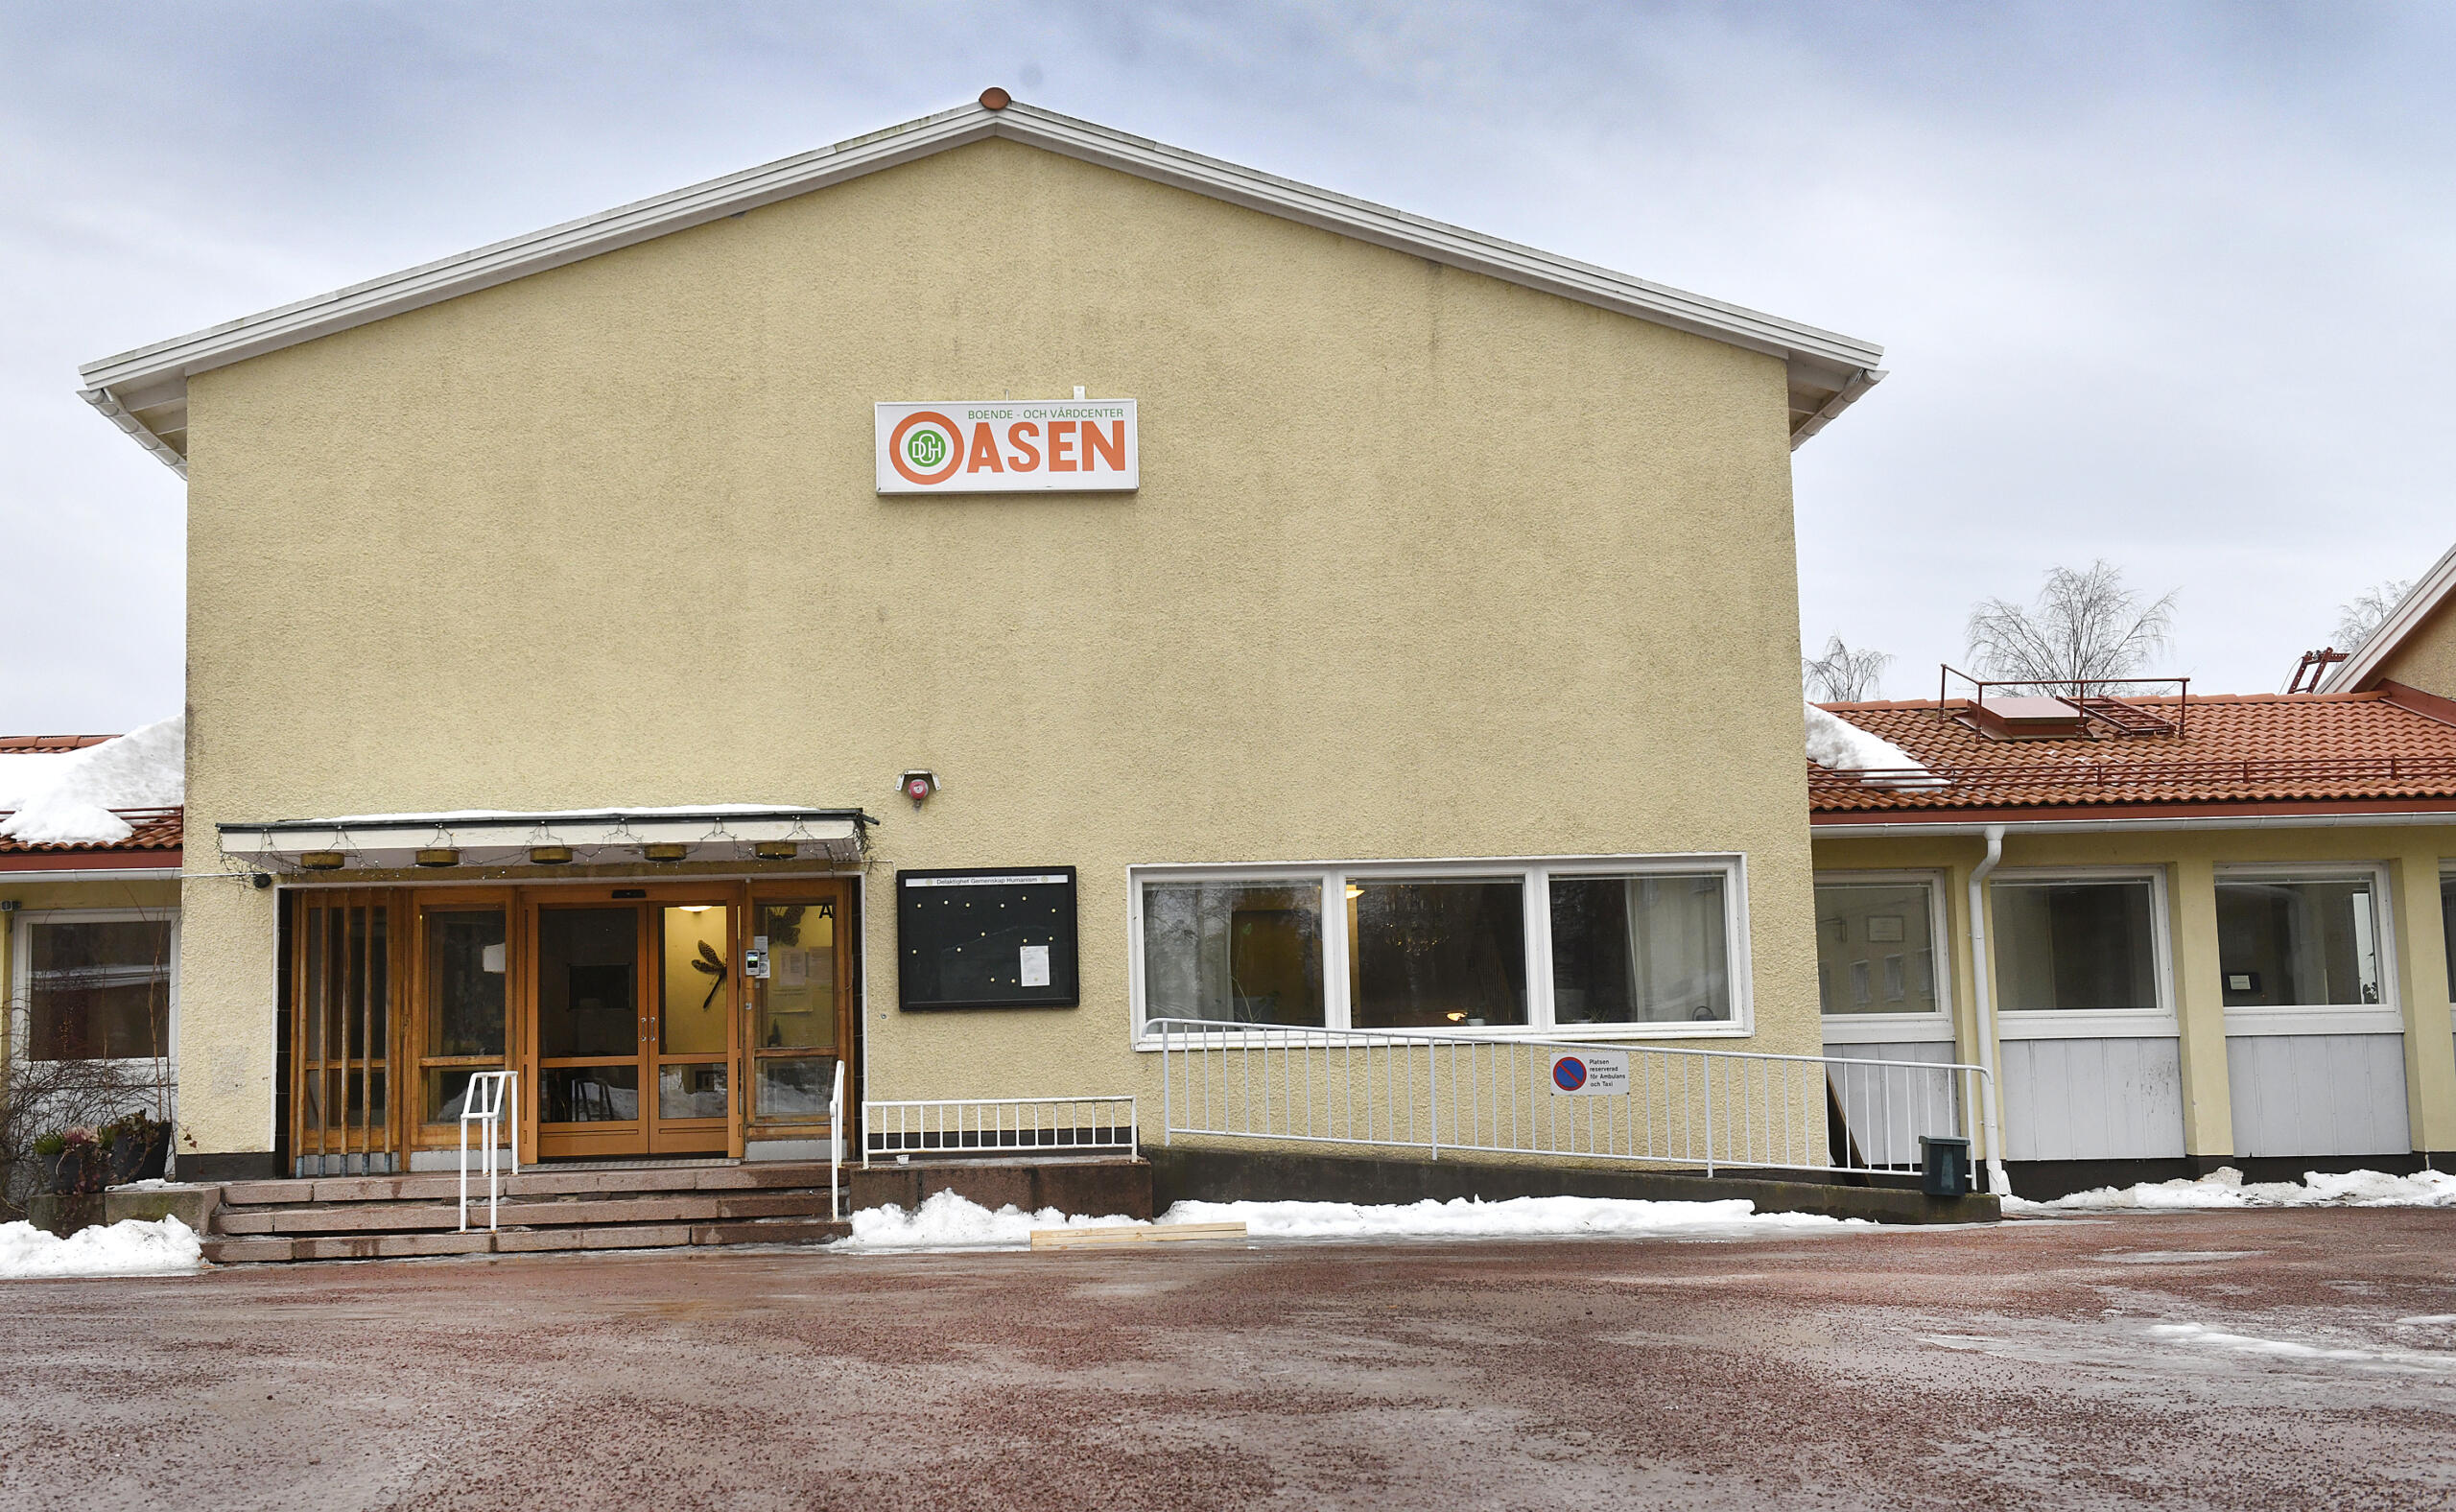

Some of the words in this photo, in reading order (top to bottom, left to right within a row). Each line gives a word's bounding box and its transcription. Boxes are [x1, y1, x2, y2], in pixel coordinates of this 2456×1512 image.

[967, 410, 1013, 420] BOENDE
[1023, 410, 1047, 419] OCH
[1050, 407, 1124, 418] VÅRDCENTER
[818, 905, 833, 919] A
